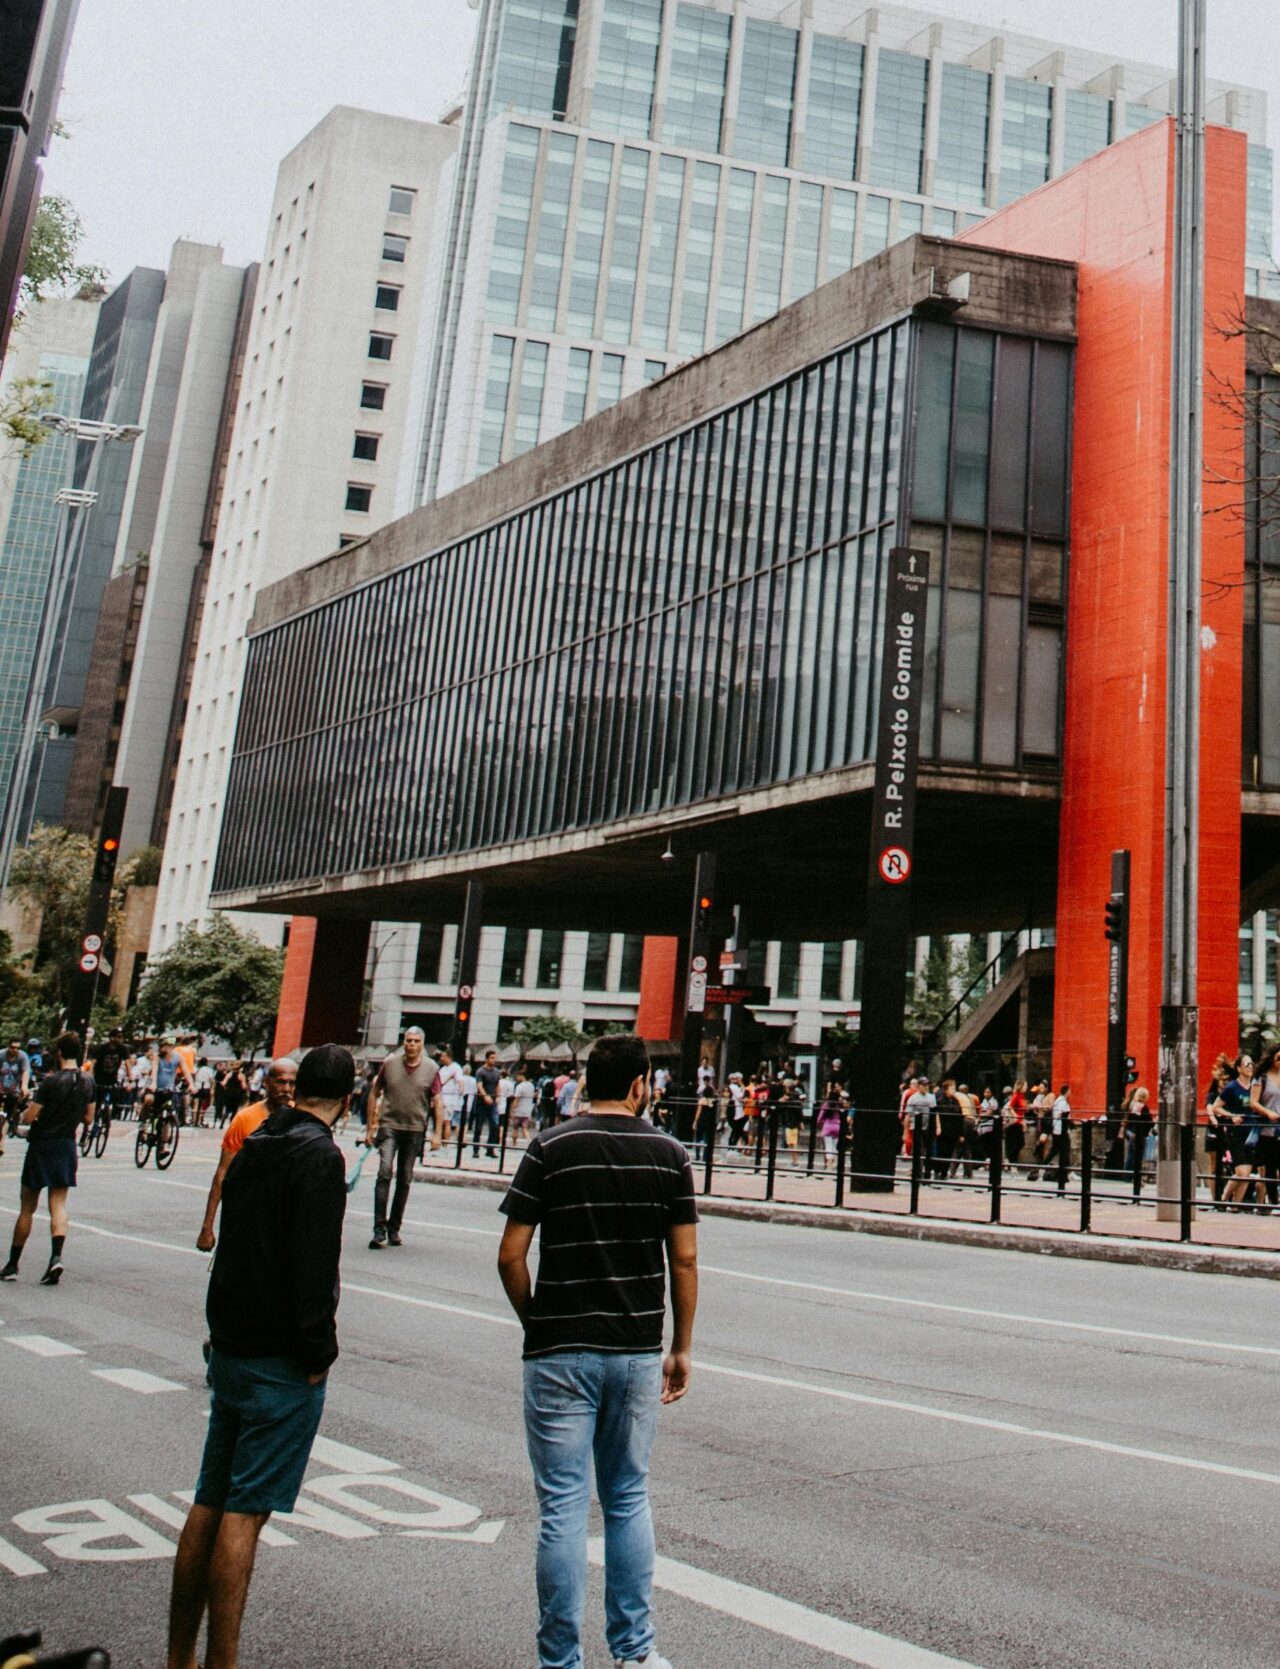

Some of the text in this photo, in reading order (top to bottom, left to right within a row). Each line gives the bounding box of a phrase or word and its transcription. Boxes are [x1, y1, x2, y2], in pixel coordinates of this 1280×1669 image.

[905, 584, 919, 592] rua
[885, 611, 914, 828] R. Peixoto Gomide
[1109, 946, 1118, 1003] Paulista
